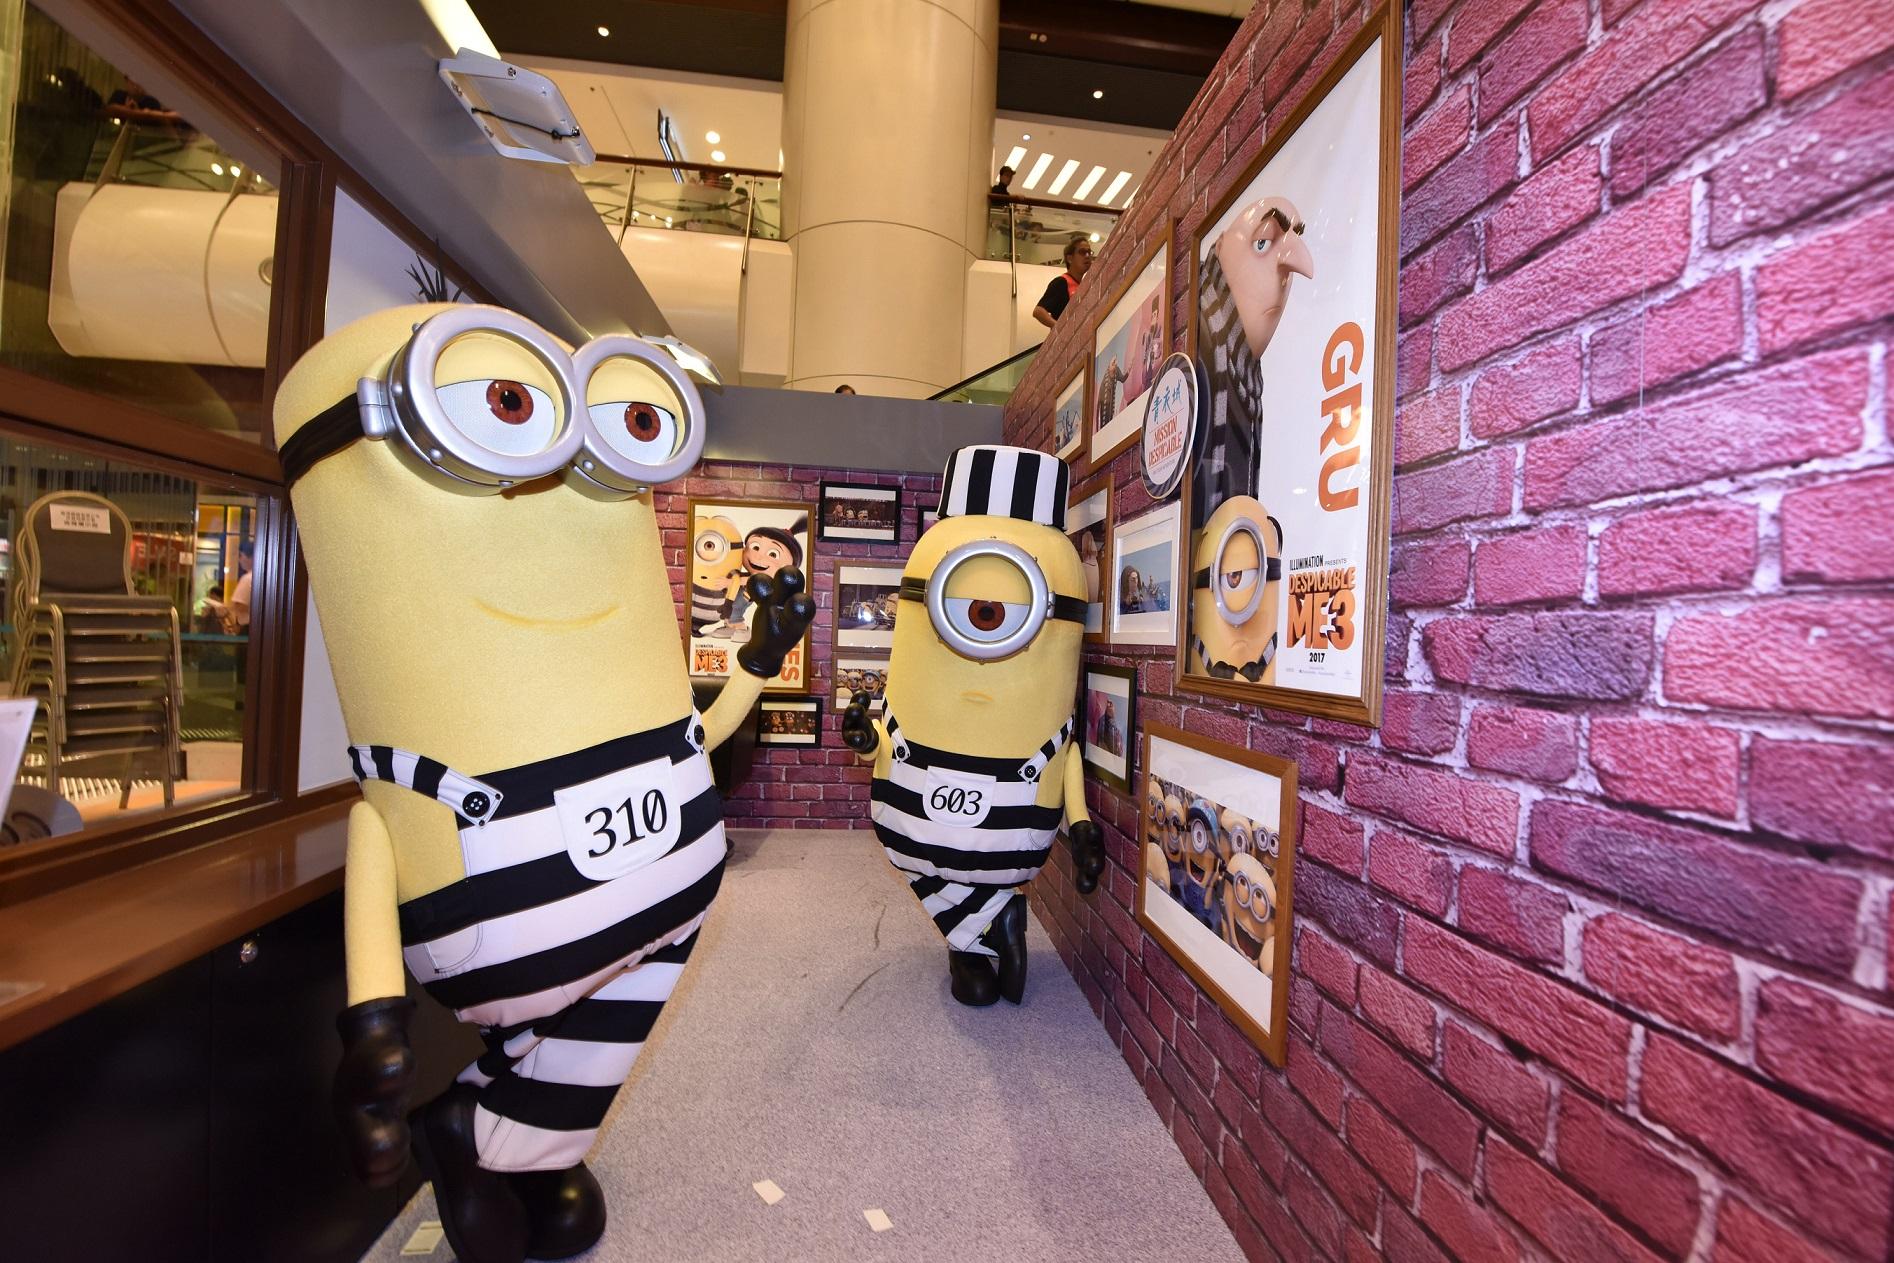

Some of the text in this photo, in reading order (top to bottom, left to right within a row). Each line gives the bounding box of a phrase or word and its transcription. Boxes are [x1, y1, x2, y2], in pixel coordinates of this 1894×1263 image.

[1153, 415, 1178, 446] MISSION
[1318, 321, 1364, 512] GRU
[1148, 432, 1183, 467] DESPICABLE
[1288, 567, 1356, 595] DESPICABLE
[1309, 652, 1326, 663] 2017
[930, 785, 983, 816] 603
[584, 789, 668, 859] 310
